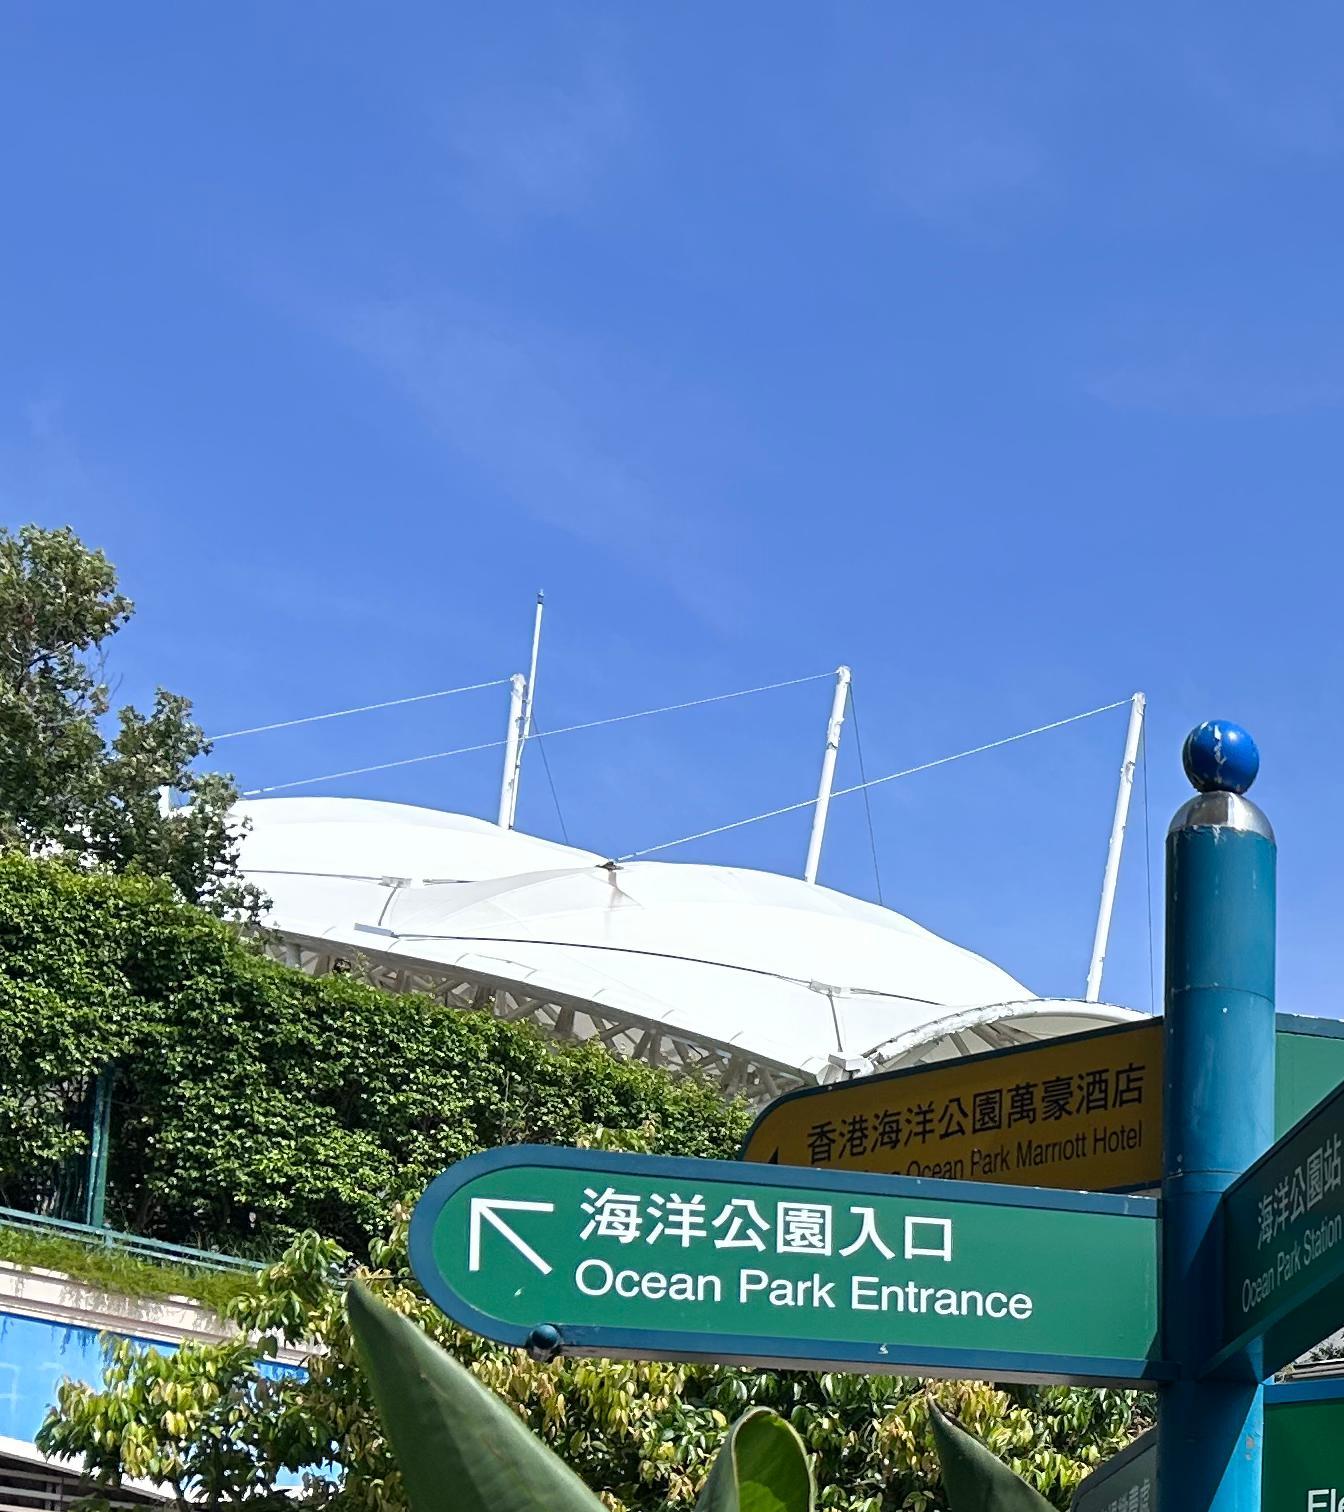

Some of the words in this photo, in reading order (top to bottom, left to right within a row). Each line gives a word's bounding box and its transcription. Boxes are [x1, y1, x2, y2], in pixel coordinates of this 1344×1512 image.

[807, 1062, 1146, 1165] 香港海洋公園萬豪酒店
[907, 1159, 964, 1179] Ocean
[970, 1147, 1010, 1177] Park
[1016, 1134, 1086, 1169] Marriott
[1093, 1120, 1143, 1154] Hotel
[579, 1186, 952, 1262] 海洋公園入口
[1257, 1132, 1342, 1250] 海洋公園站
[575, 1259, 721, 1302] Ocean
[739, 1269, 836, 1309] Park
[851, 1275, 1033, 1320] Entrance
[1242, 1265, 1275, 1313] Ocean
[1276, 1242, 1301, 1287] Park
[1303, 1214, 1343, 1266] Station
